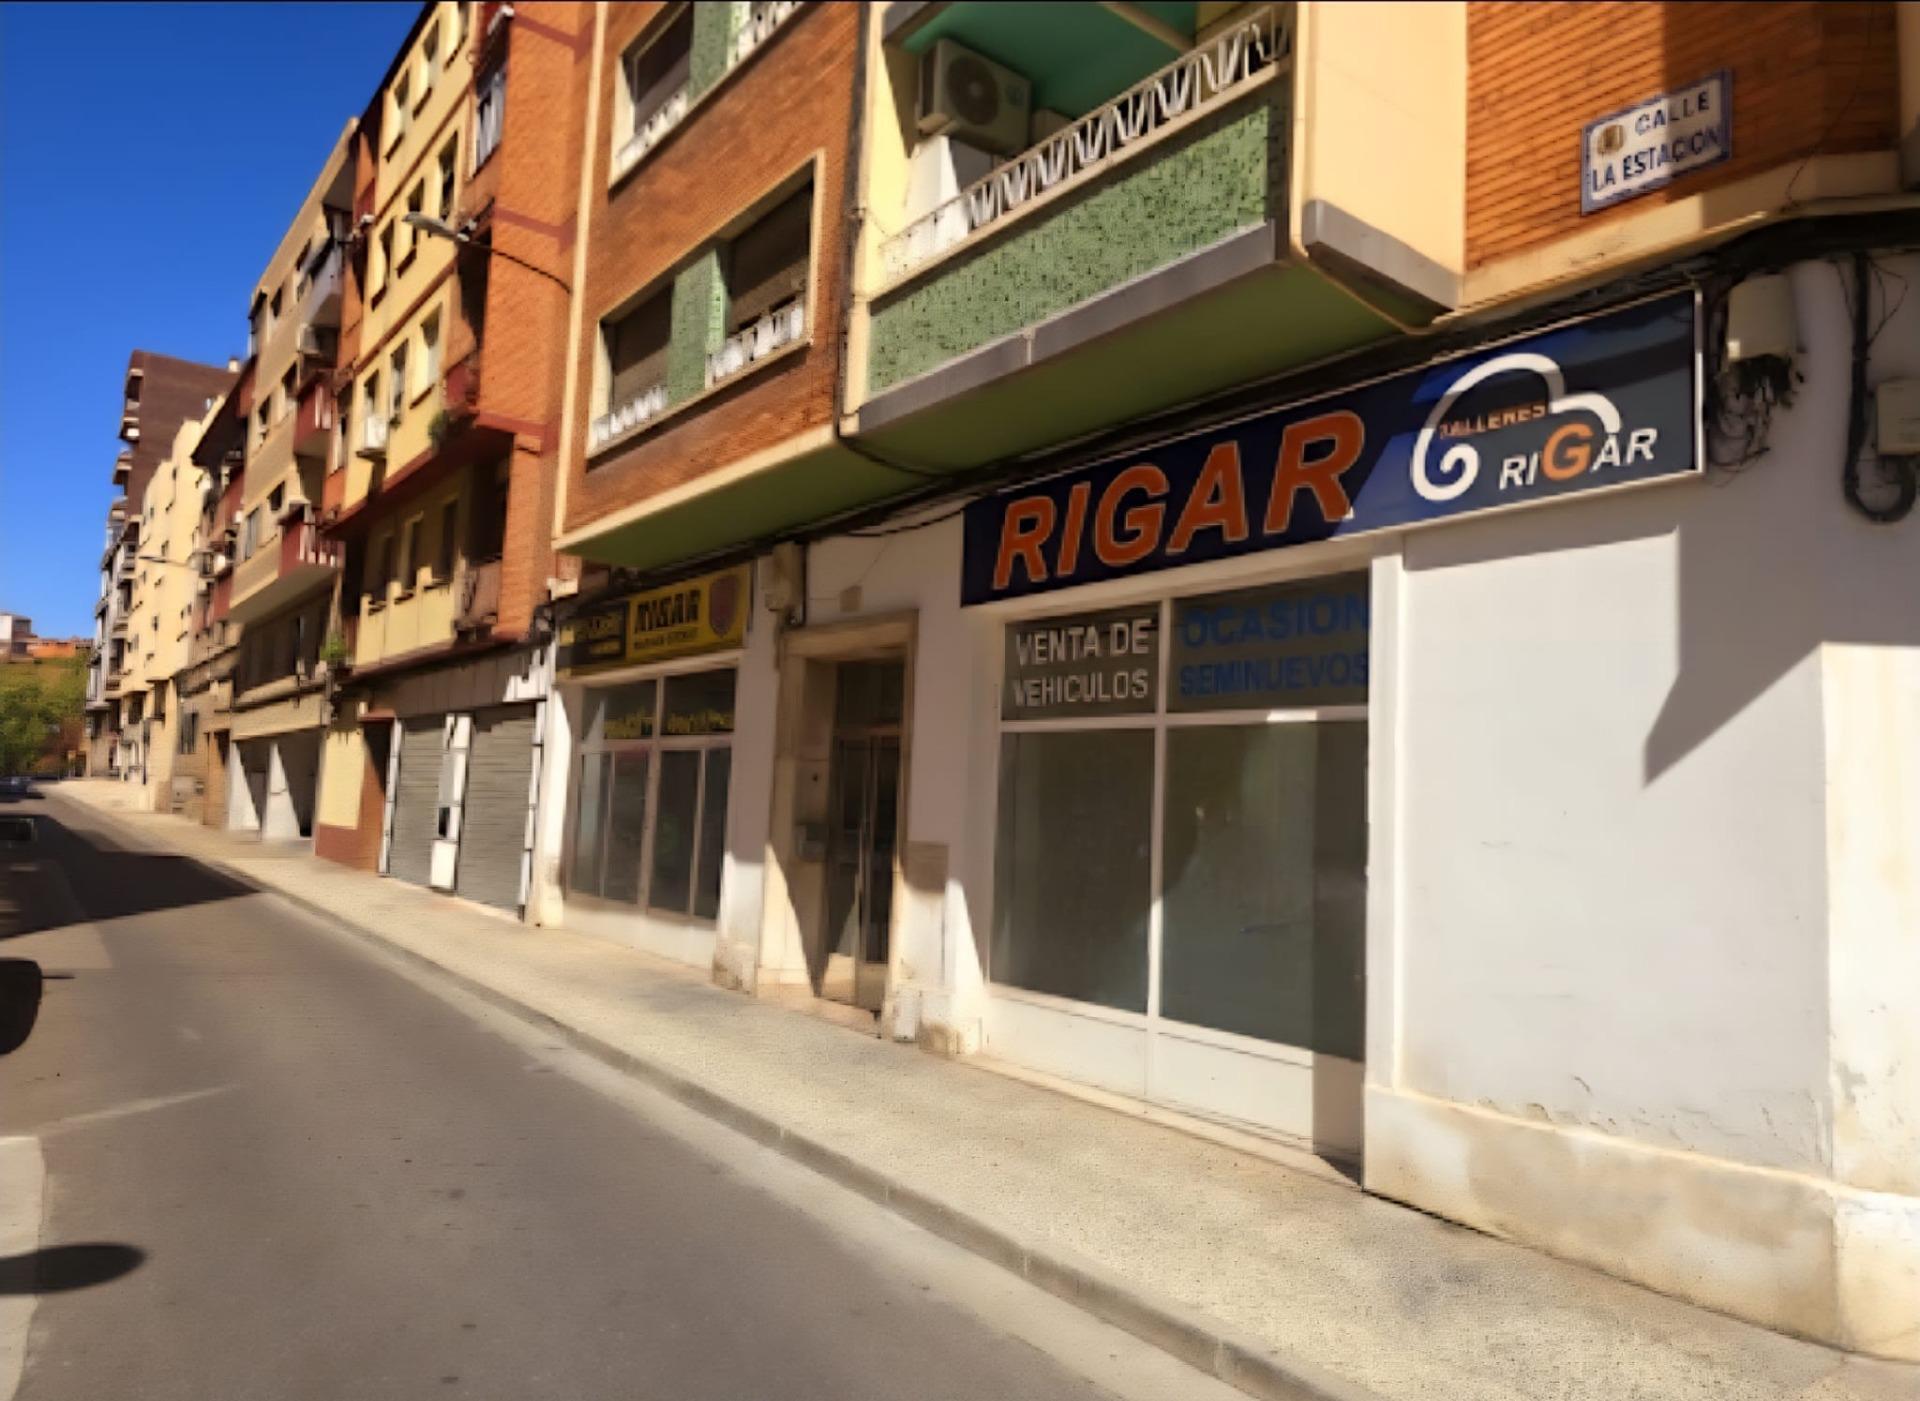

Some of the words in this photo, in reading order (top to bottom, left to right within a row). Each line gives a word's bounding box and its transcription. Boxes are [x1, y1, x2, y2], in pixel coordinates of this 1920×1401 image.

[1635, 91, 1709, 136] CALLE
[1623, 129, 1719, 180] ESTACON
[992, 409, 1365, 590] RIGAR
[1015, 624, 1101, 667] VENTA
[1110, 618, 1153, 656] DE
[1180, 592, 1371, 648] OCASION
[1013, 668, 1149, 708] VEHICULOS
[1179, 652, 1370, 697] SEMINUEVOS
